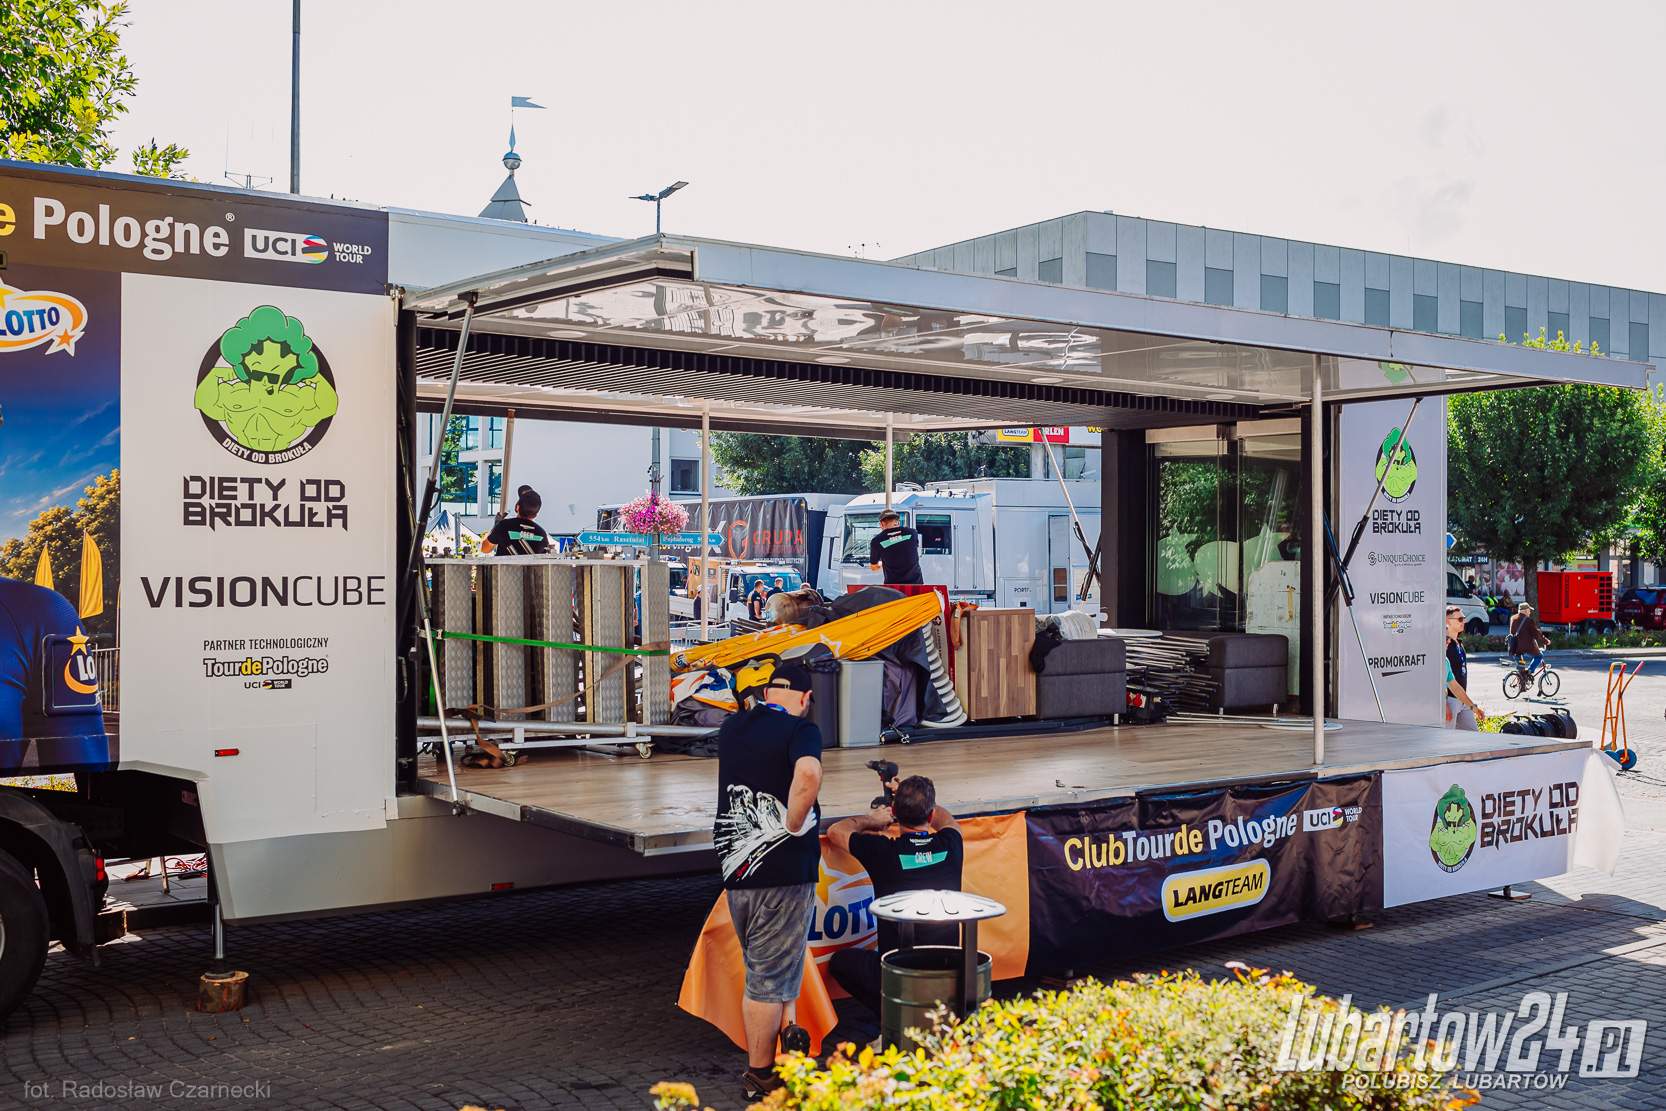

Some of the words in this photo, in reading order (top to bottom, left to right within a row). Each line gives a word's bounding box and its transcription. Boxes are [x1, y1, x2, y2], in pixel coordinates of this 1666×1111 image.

[251, 234, 297, 257] UCI
[333, 242, 372, 255] WORLD
[334, 252, 364, 264] TOUR
[221, 438, 251, 459] DIETY
[251, 452, 266, 463] OD
[268, 441, 313, 464] BROKUŁA
[182, 475, 287, 501] DIETY
[299, 478, 346, 503] OD
[182, 502, 349, 532] BROKUŁA
[1372, 509, 1403, 522] DIETY
[1406, 509, 1421, 522] OD
[1372, 521, 1422, 536] BROKUŁA
[752, 528, 804, 545] GRUPA
[140, 575, 386, 608] VISIONCUBE
[1369, 591, 1425, 605] VISIONCUBE
[203, 639, 246, 651] PARTNER
[249, 637, 329, 650] TECHNOLOGICZNY
[1367, 653, 1427, 669] PROMOKRAFT
[244, 681, 261, 689] UCI
[1480, 786, 1543, 820] DIETY
[1548, 781, 1580, 809] OD
[1344, 806, 1363, 816] WORLD
[1345, 814, 1359, 823] TOUR
[1309, 812, 1331, 827] UCI
[1208, 813, 1298, 850] Pologne
[1172, 871, 1264, 909] LANGTEAM
